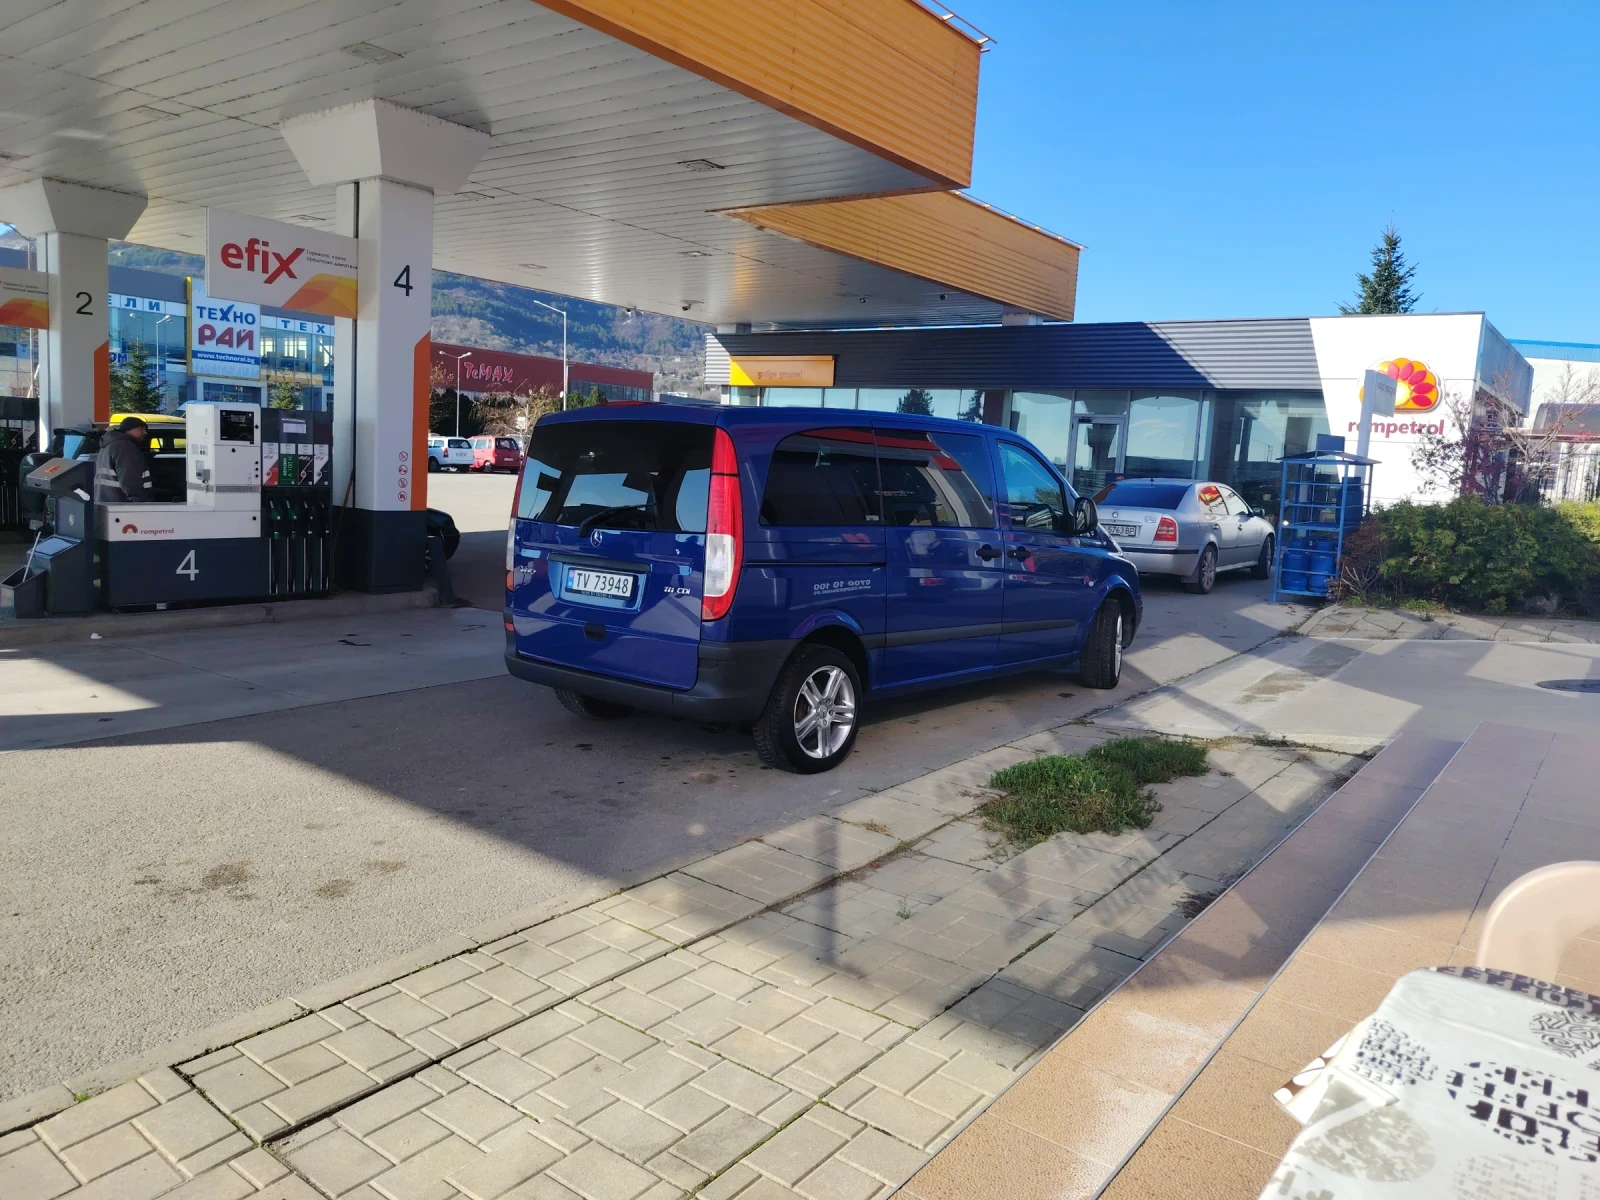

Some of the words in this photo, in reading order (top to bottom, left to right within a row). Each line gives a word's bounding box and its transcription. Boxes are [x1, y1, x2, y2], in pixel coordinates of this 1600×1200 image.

[220, 237, 306, 285] efix
[393, 264, 414, 297] 4
[76, 291, 93, 316] 2
[196, 303, 256, 325] ТЕХНО
[198, 323, 254, 351] РАЙ
[140, 528, 175, 536] rompetrol
[175, 549, 200, 581] 4
[576, 572, 591, 589] TV
[593, 574, 629, 594] 73948
